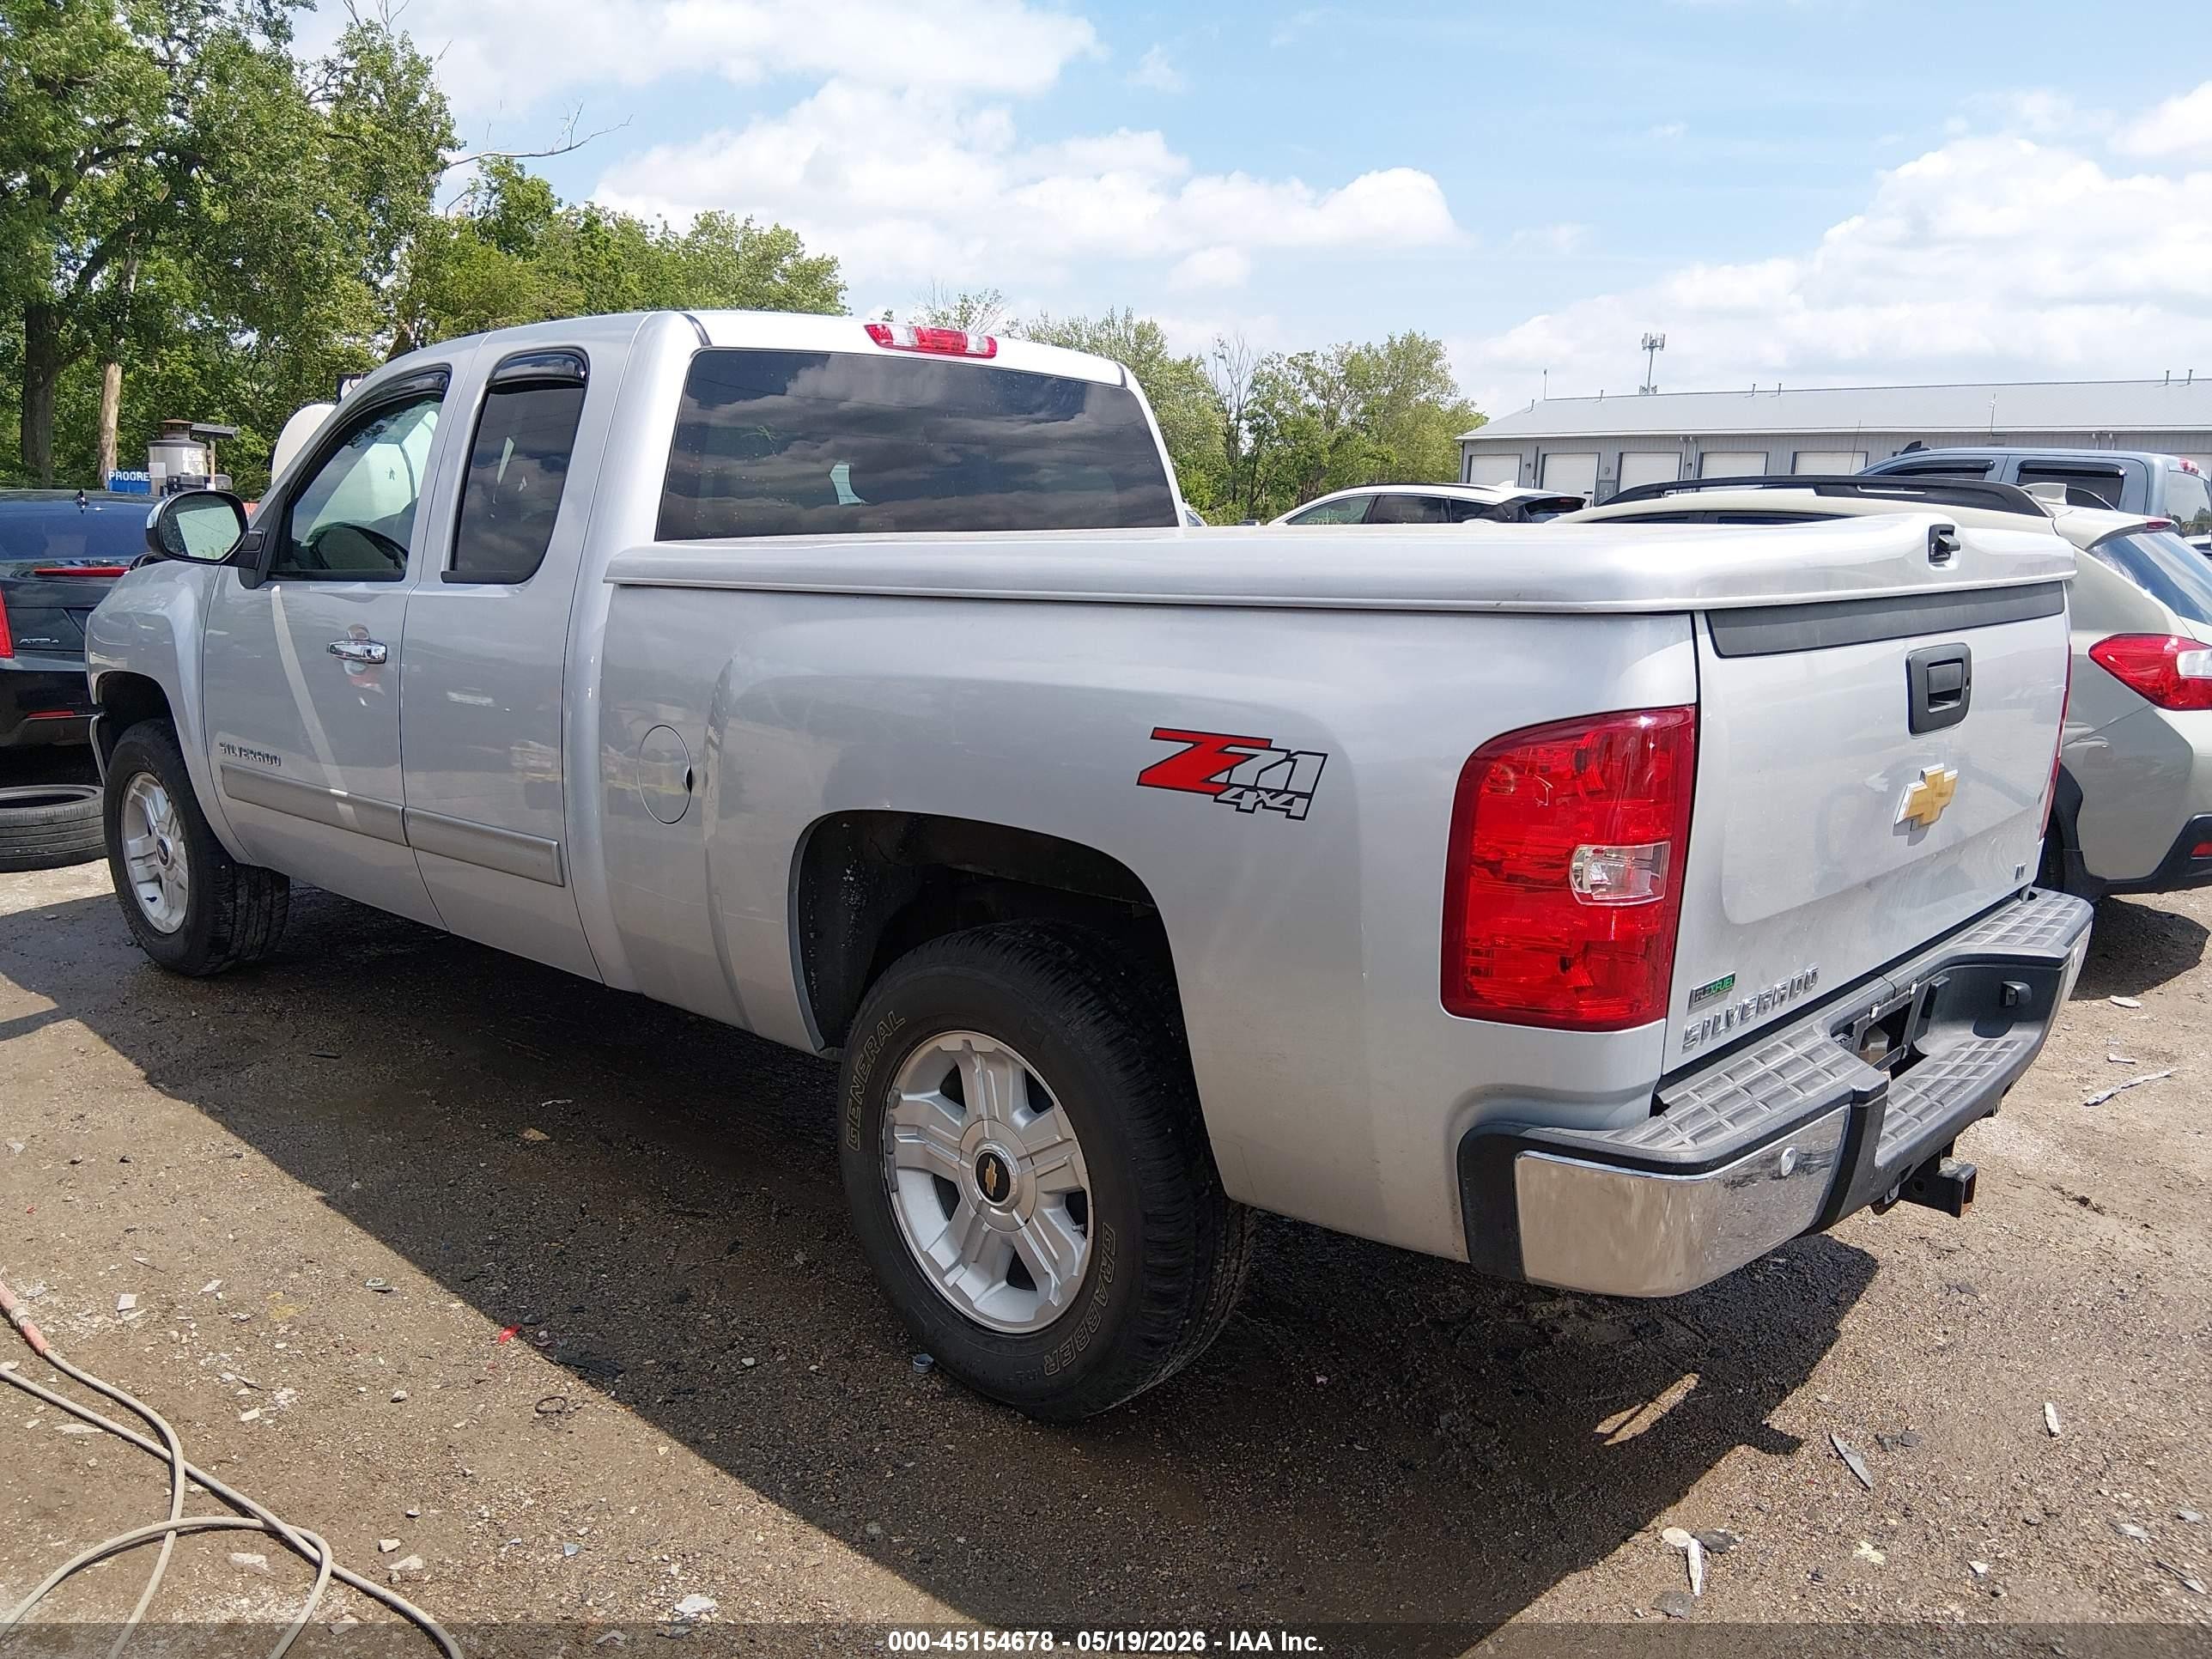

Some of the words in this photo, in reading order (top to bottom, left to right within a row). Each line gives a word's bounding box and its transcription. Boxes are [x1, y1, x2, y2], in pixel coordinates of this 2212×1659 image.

[1136, 726, 1328, 795] Z71
[1682, 965, 1819, 1051] SILVERADO
[846, 1010, 907, 1152] GENERAL
[1043, 1222, 1116, 1376] GRABBER
